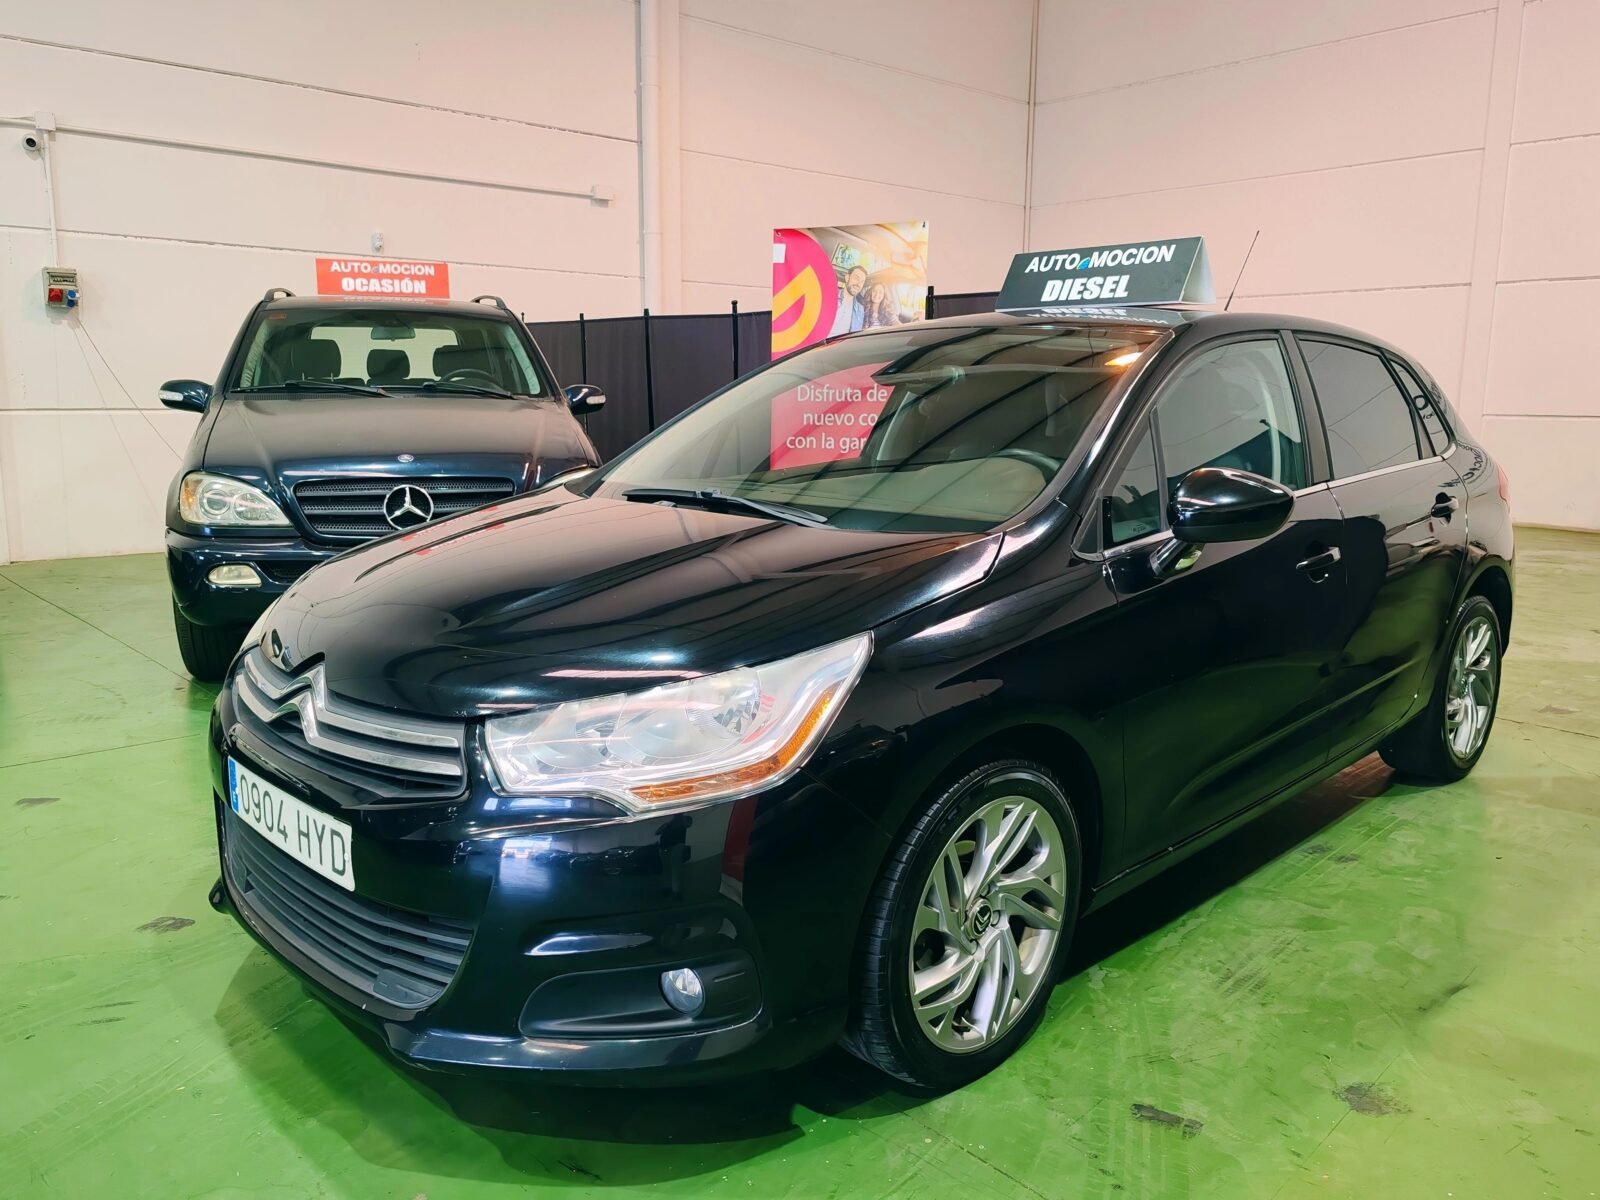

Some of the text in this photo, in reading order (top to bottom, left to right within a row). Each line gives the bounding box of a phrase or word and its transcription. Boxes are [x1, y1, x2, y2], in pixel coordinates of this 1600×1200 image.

[341, 277, 427, 294] OCASIÓN
[1040, 274, 1131, 302] DIESEL
[797, 383, 888, 402] Disfruta de
[803, 412, 855, 426] nuevo
[786, 436, 817, 449] con
[821, 432, 835, 449] la
[240, 774, 347, 877] 0904 HYD
